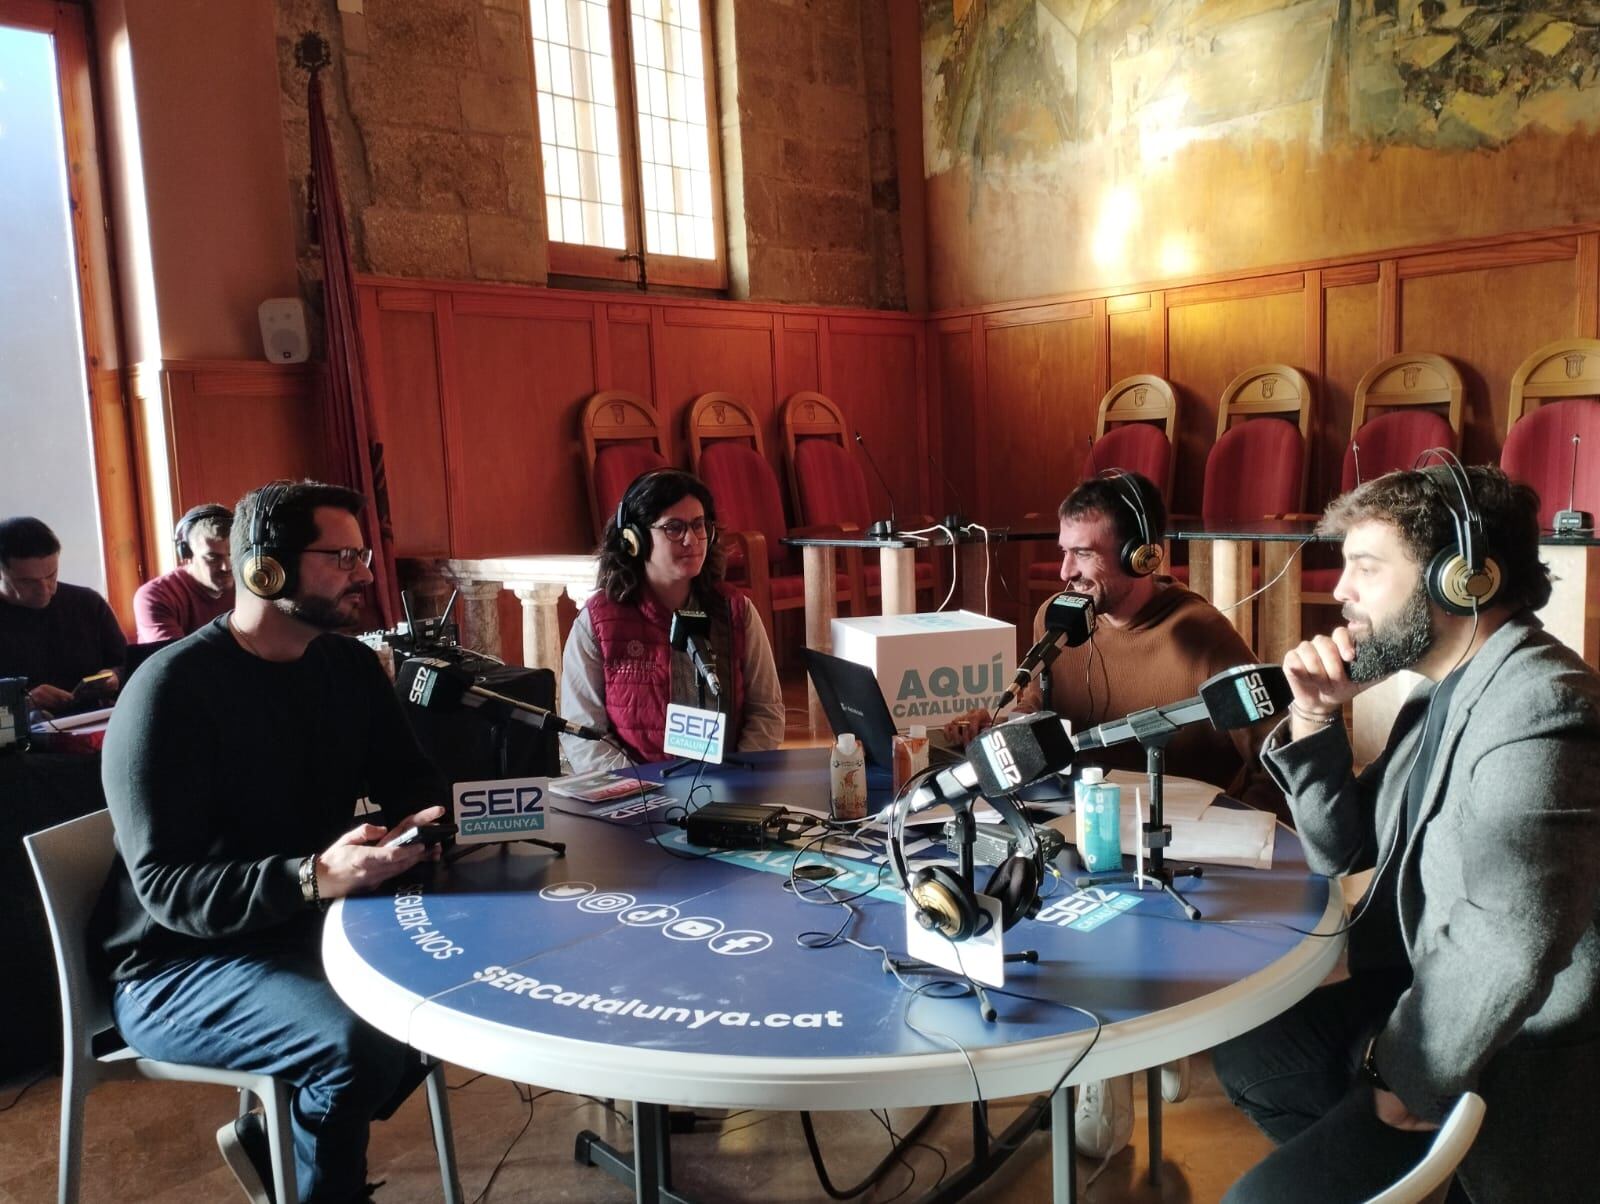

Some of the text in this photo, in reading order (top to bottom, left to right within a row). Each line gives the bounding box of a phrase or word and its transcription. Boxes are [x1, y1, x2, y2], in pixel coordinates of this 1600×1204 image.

[408, 666, 431, 704] SER
[896, 652, 1004, 701] AQUÍ
[1244, 672, 1275, 718] SER
[893, 694, 1003, 718] CATALUNYA
[669, 712, 720, 741] SER
[988, 730, 1022, 787] SER
[460, 786, 544, 818] SER
[464, 818, 539, 832] CATALUNYA
[1035, 887, 1120, 927] SER
